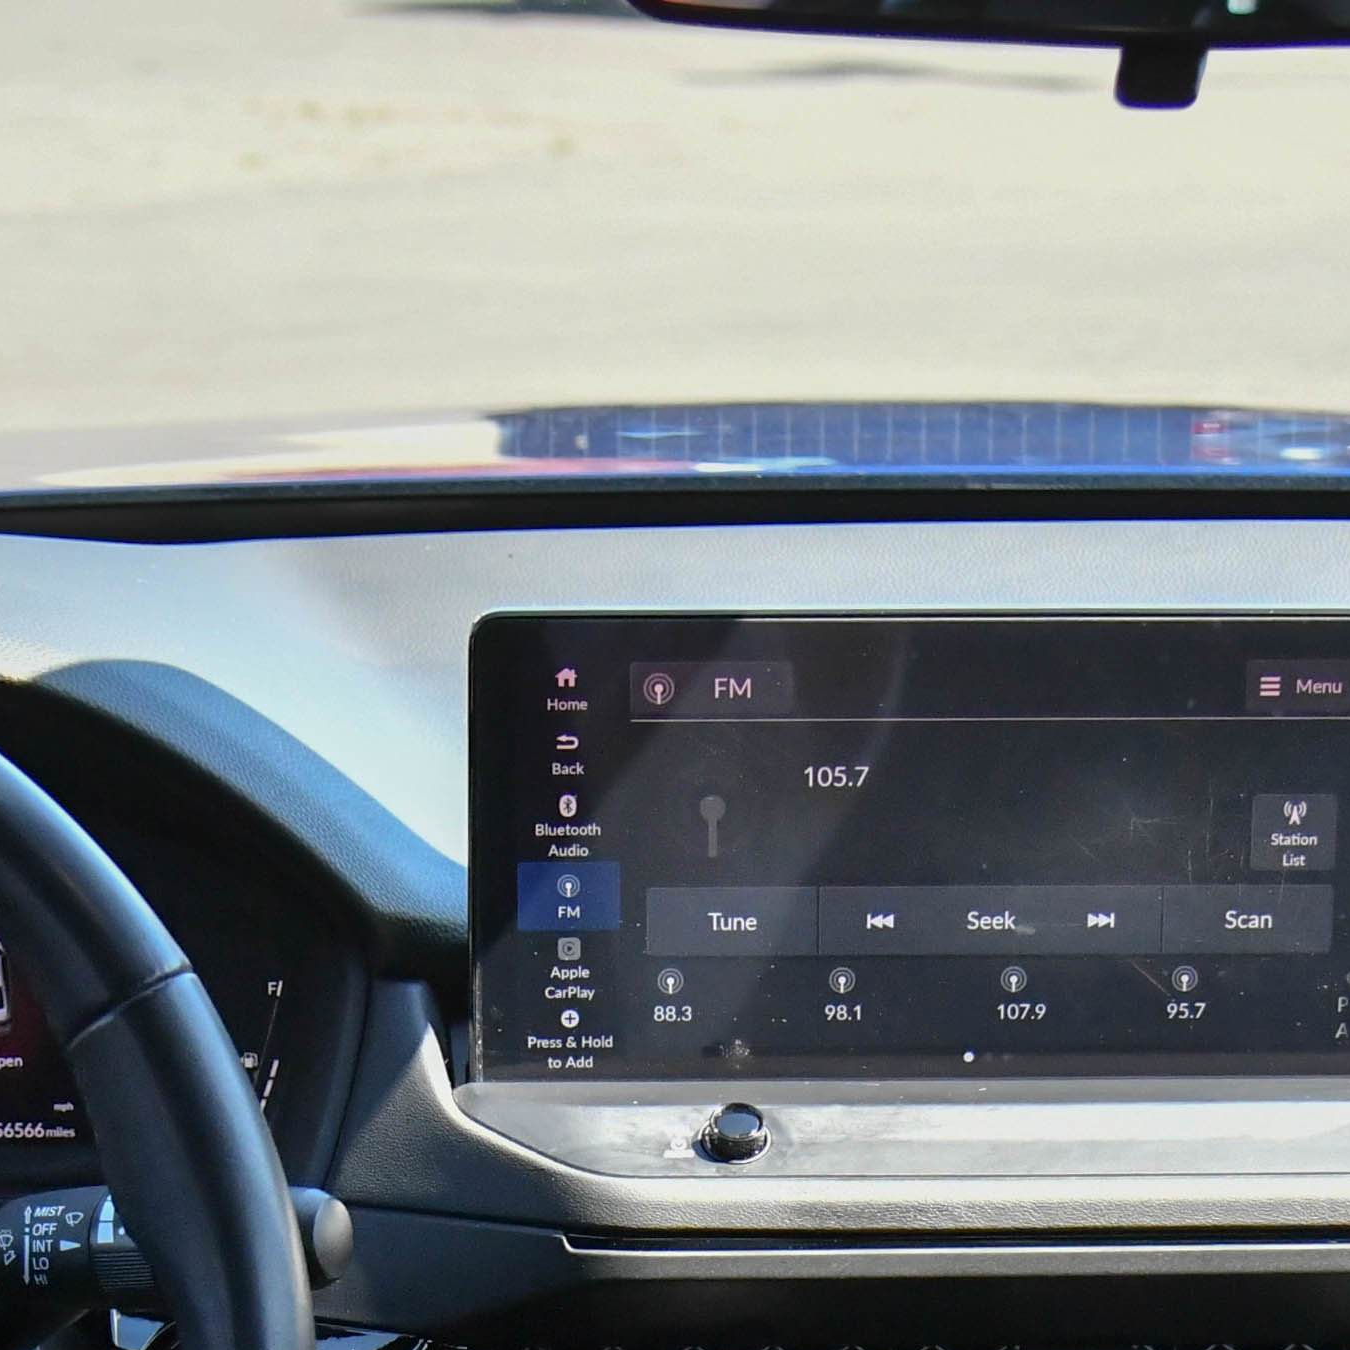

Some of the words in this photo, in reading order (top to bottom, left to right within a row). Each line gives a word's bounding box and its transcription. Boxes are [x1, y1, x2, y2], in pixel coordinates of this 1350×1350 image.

[713, 677, 753, 700] FM
[1295, 678, 1343, 695] Menu
[546, 698, 588, 712] Home
[551, 762, 585, 776] Back
[803, 765, 870, 788] 105.7
[534, 823, 602, 837] Bluetooth
[1270, 832, 1318, 847] Station
[547, 844, 589, 858] Audio
[1282, 852, 1306, 867] List
[557, 906, 581, 919] FM
[966, 910, 1017, 930] Seek
[1224, 910, 1273, 930] Scan
[707, 912, 758, 932] Tune
[549, 965, 590, 982] Apple
[544, 986, 595, 1001] CarPlay
[653, 1006, 693, 1022] 88.3
[824, 1004, 863, 1021] 98.1
[996, 1003, 1047, 1021] 107.9
[1165, 1002, 1207, 1020] 95.7
[527, 1036, 563, 1049] Press
[565, 1036, 577, 1048] &
[581, 1035, 614, 1049] Hold
[547, 1056, 562, 1069] to
[564, 1055, 594, 1069] Add
[45, 1126, 76, 1139] miles
[33, 1204, 66, 1218] MIST
[32, 1222, 58, 1236] OFF
[32, 1239, 53, 1252] INT
[32, 1256, 50, 1270] LO
[34, 1274, 49, 1286] HI
